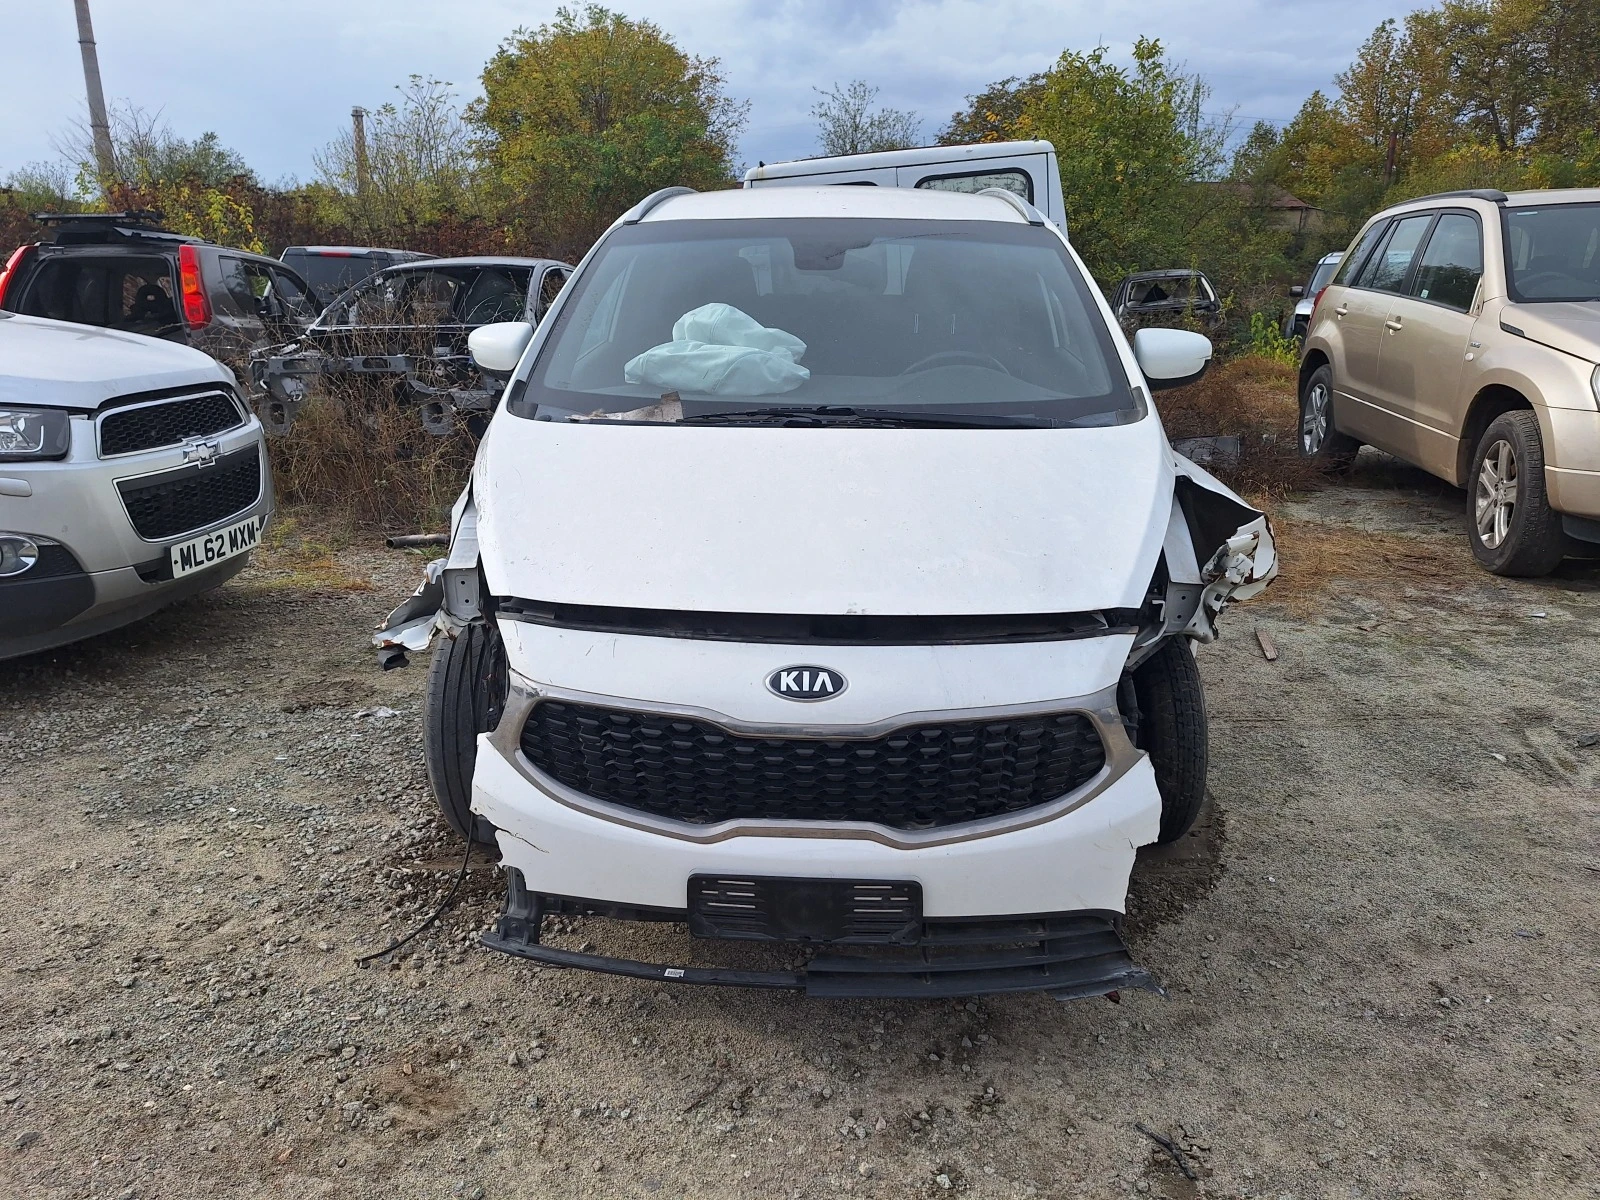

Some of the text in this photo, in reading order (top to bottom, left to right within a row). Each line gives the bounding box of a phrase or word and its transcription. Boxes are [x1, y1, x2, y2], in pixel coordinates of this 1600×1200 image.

[180, 521, 256, 571] ML62 MXM
[780, 671, 834, 692] KIA
